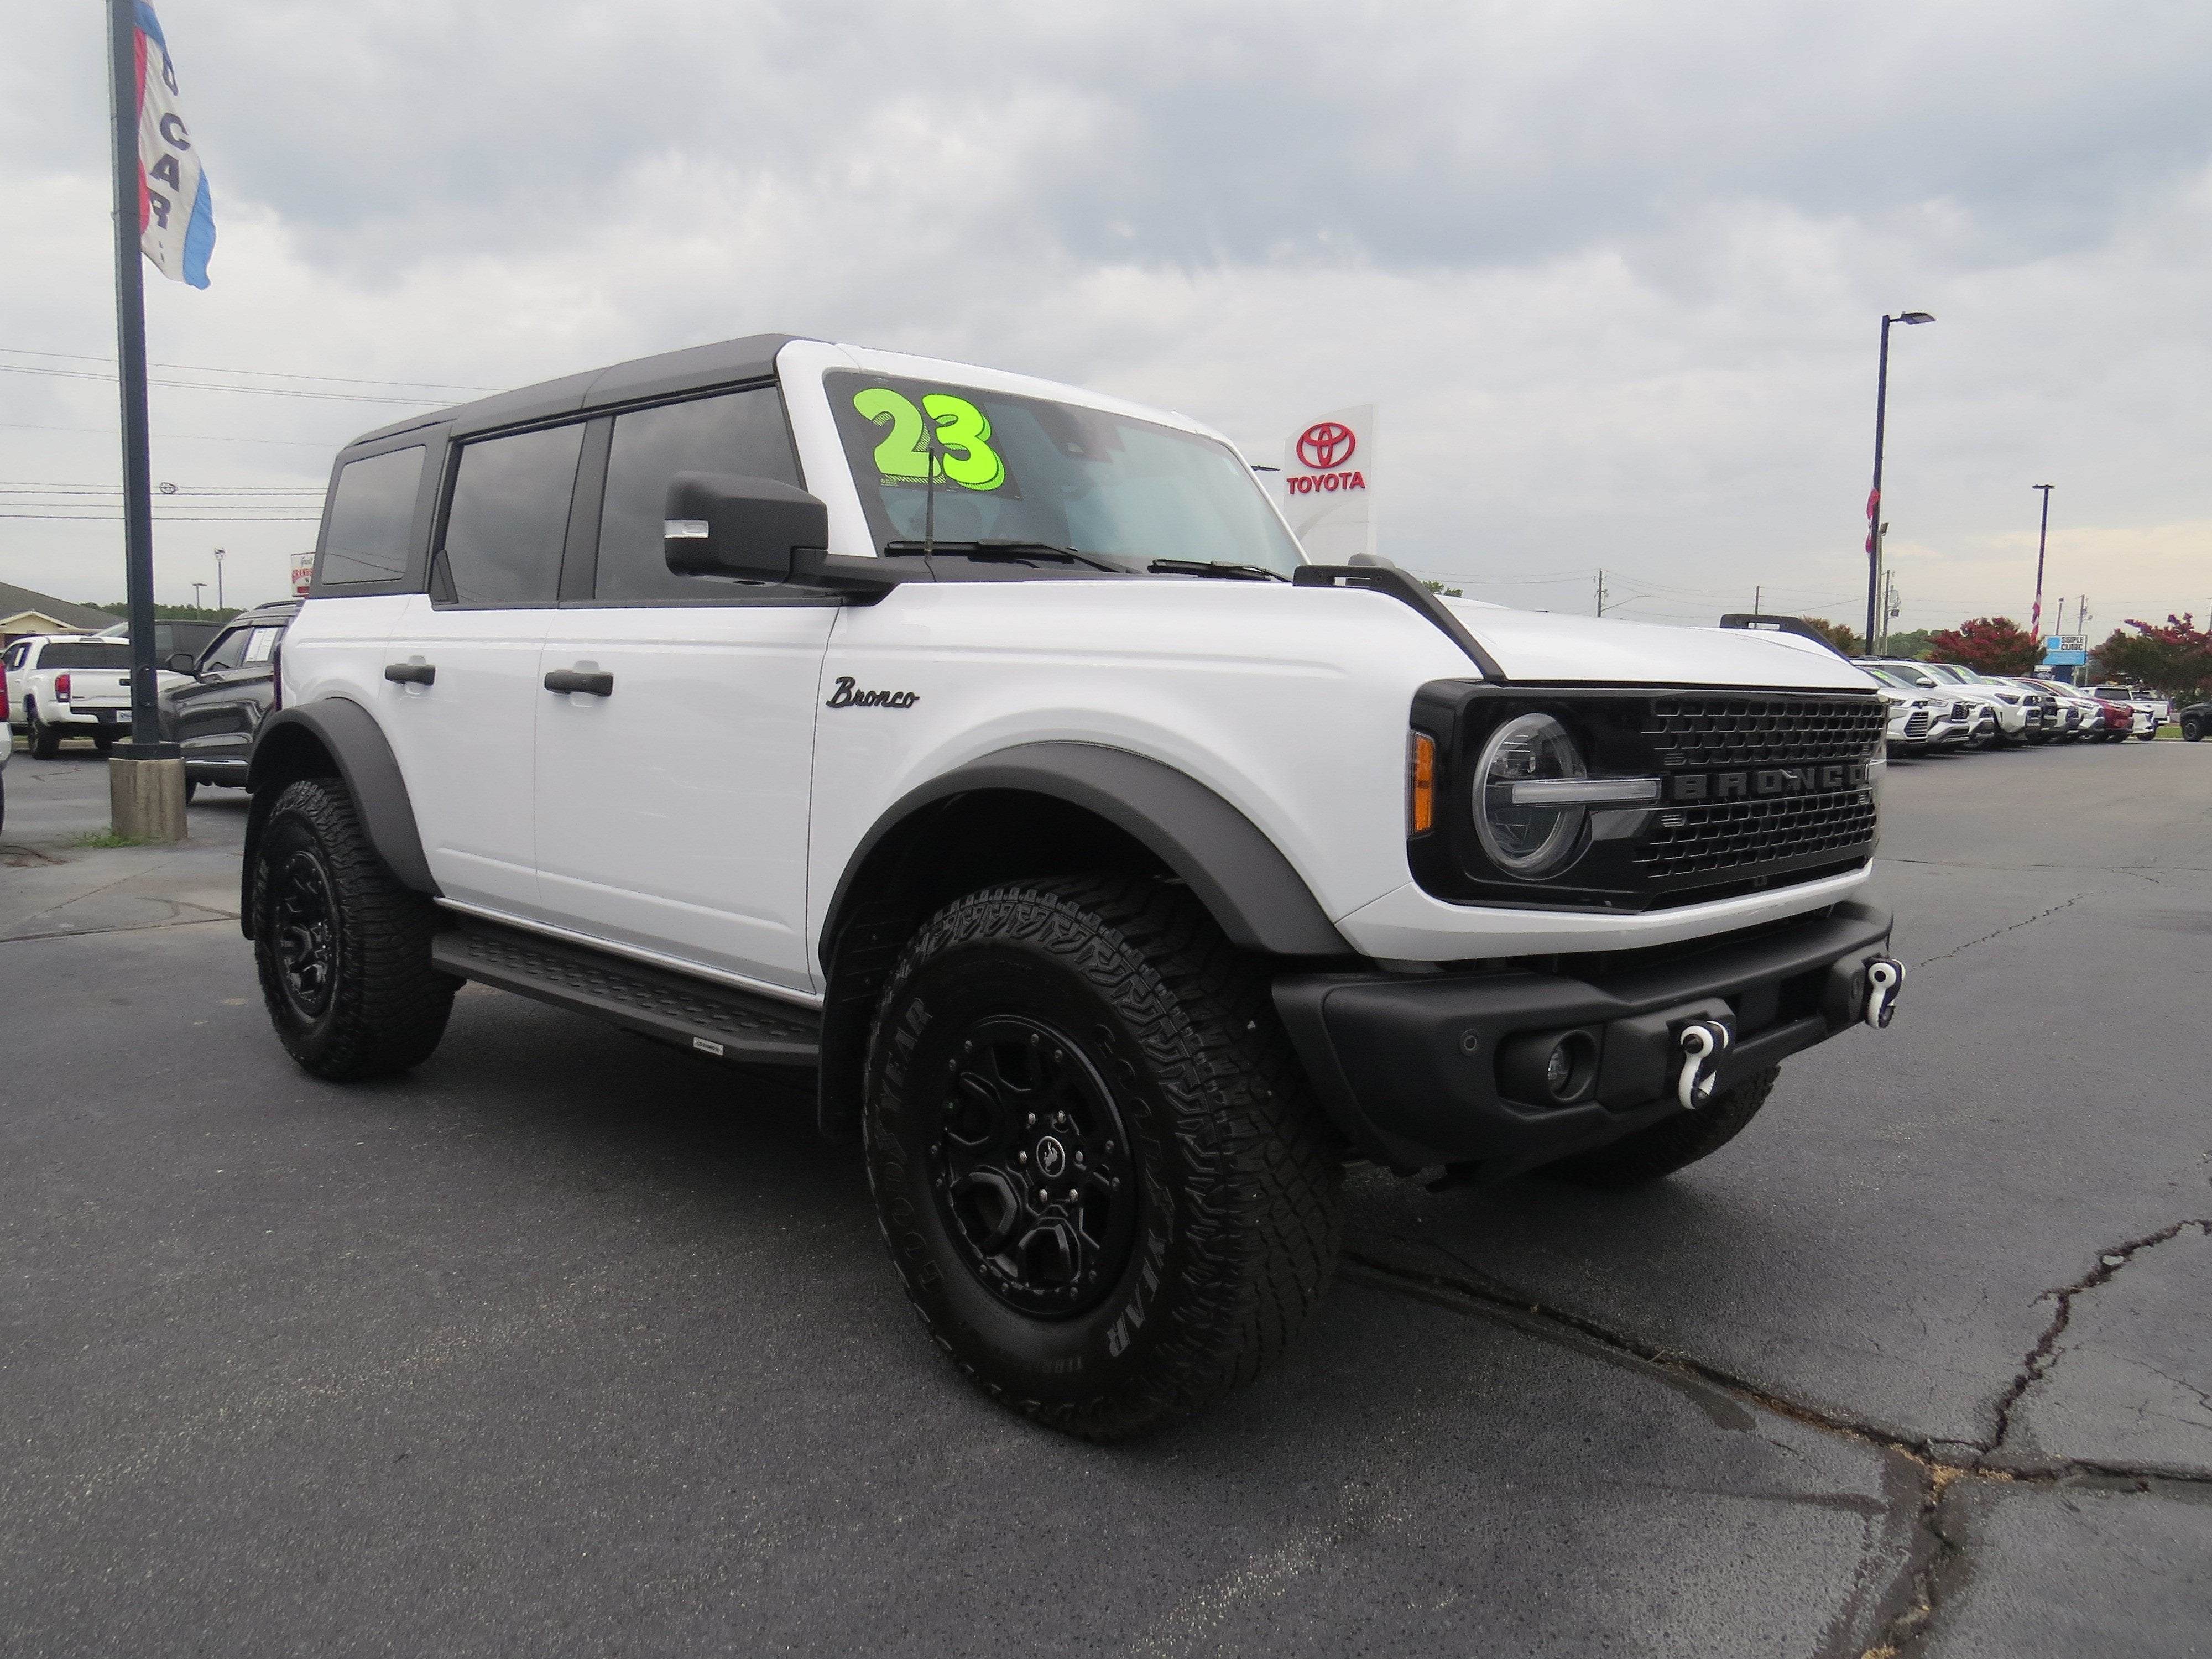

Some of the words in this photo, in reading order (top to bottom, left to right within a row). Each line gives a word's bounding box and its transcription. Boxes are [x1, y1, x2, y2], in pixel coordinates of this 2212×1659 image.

[853, 388, 1006, 491] 23
[1286, 471, 1365, 494] TOYOTA
[826, 676, 920, 708] Bronco
[1674, 764, 1866, 800] BRONCO
